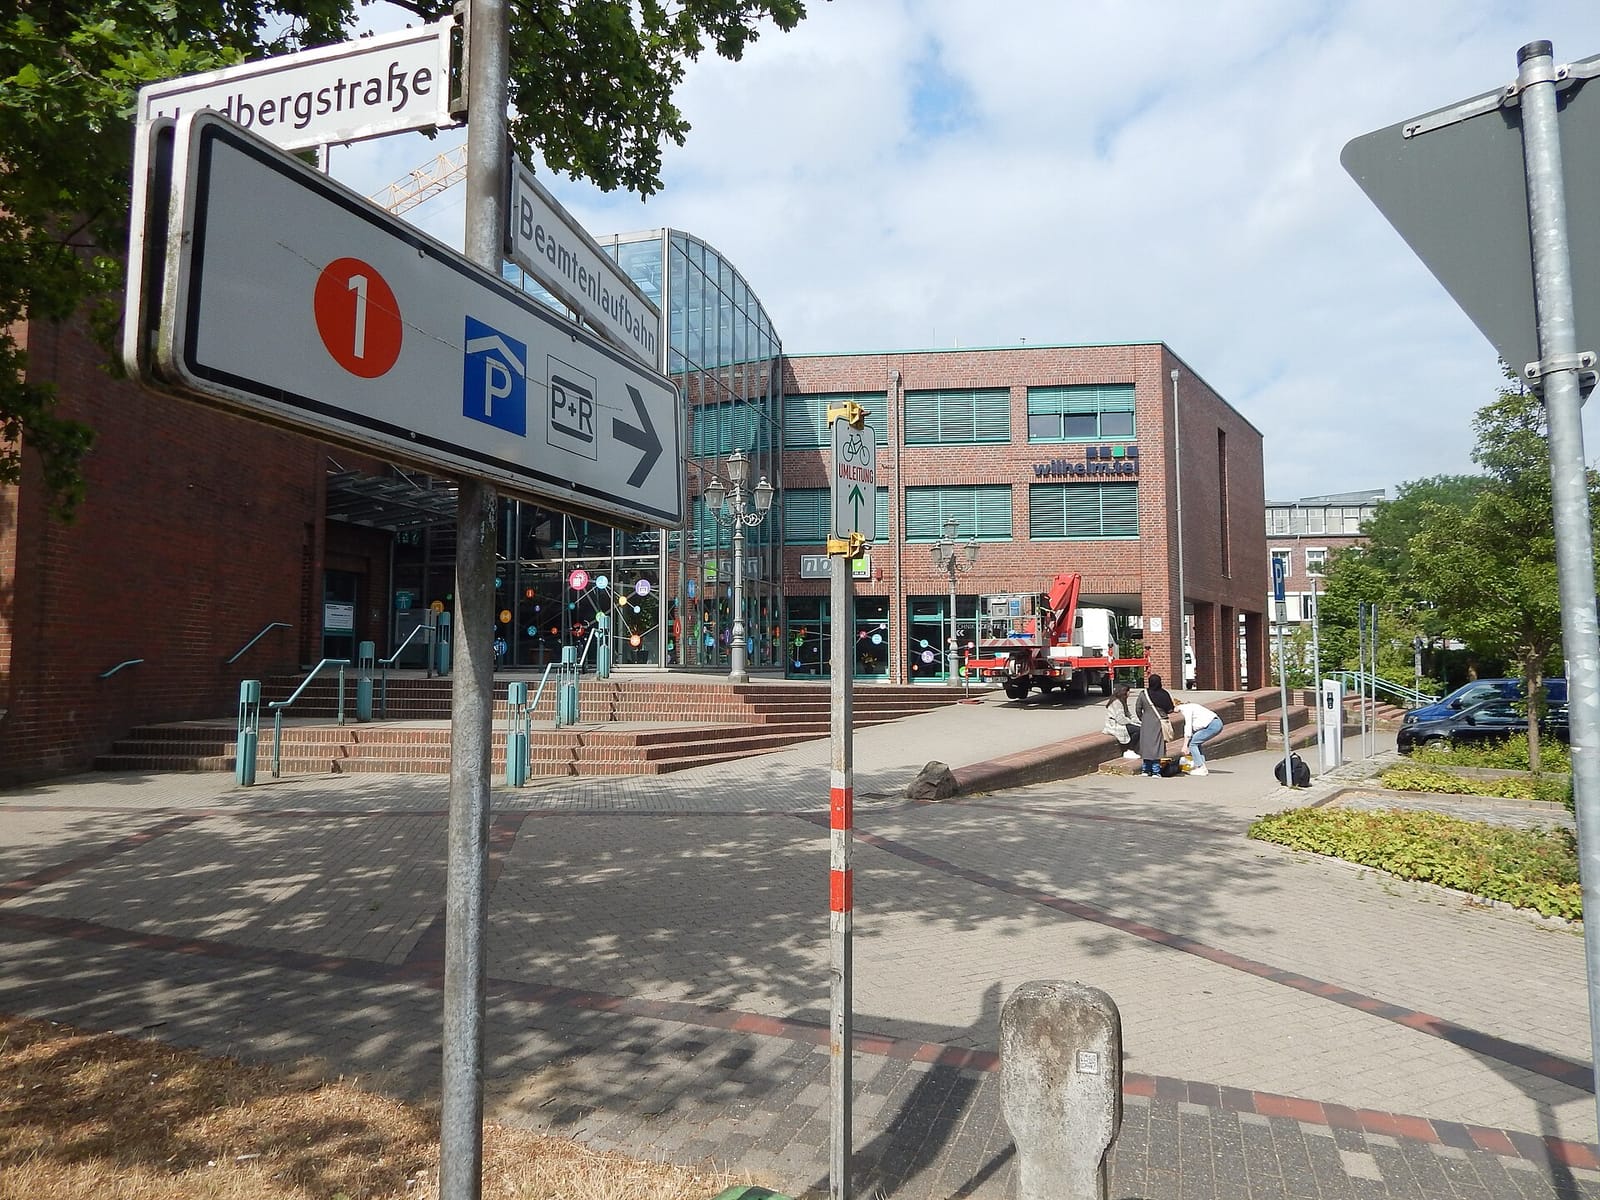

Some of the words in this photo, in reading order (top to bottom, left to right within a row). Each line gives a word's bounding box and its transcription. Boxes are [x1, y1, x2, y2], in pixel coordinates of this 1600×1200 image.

[158, 62, 432, 129] dbergstraße
[520, 195, 655, 355] Beamtenlaufbahn
[347, 274, 369, 360] 1
[484, 356, 512, 417] P
[551, 383, 594, 435] P+R
[838, 463, 874, 484] UMLEITUNG
[1033, 458, 1139, 477] wilhelm.tel
